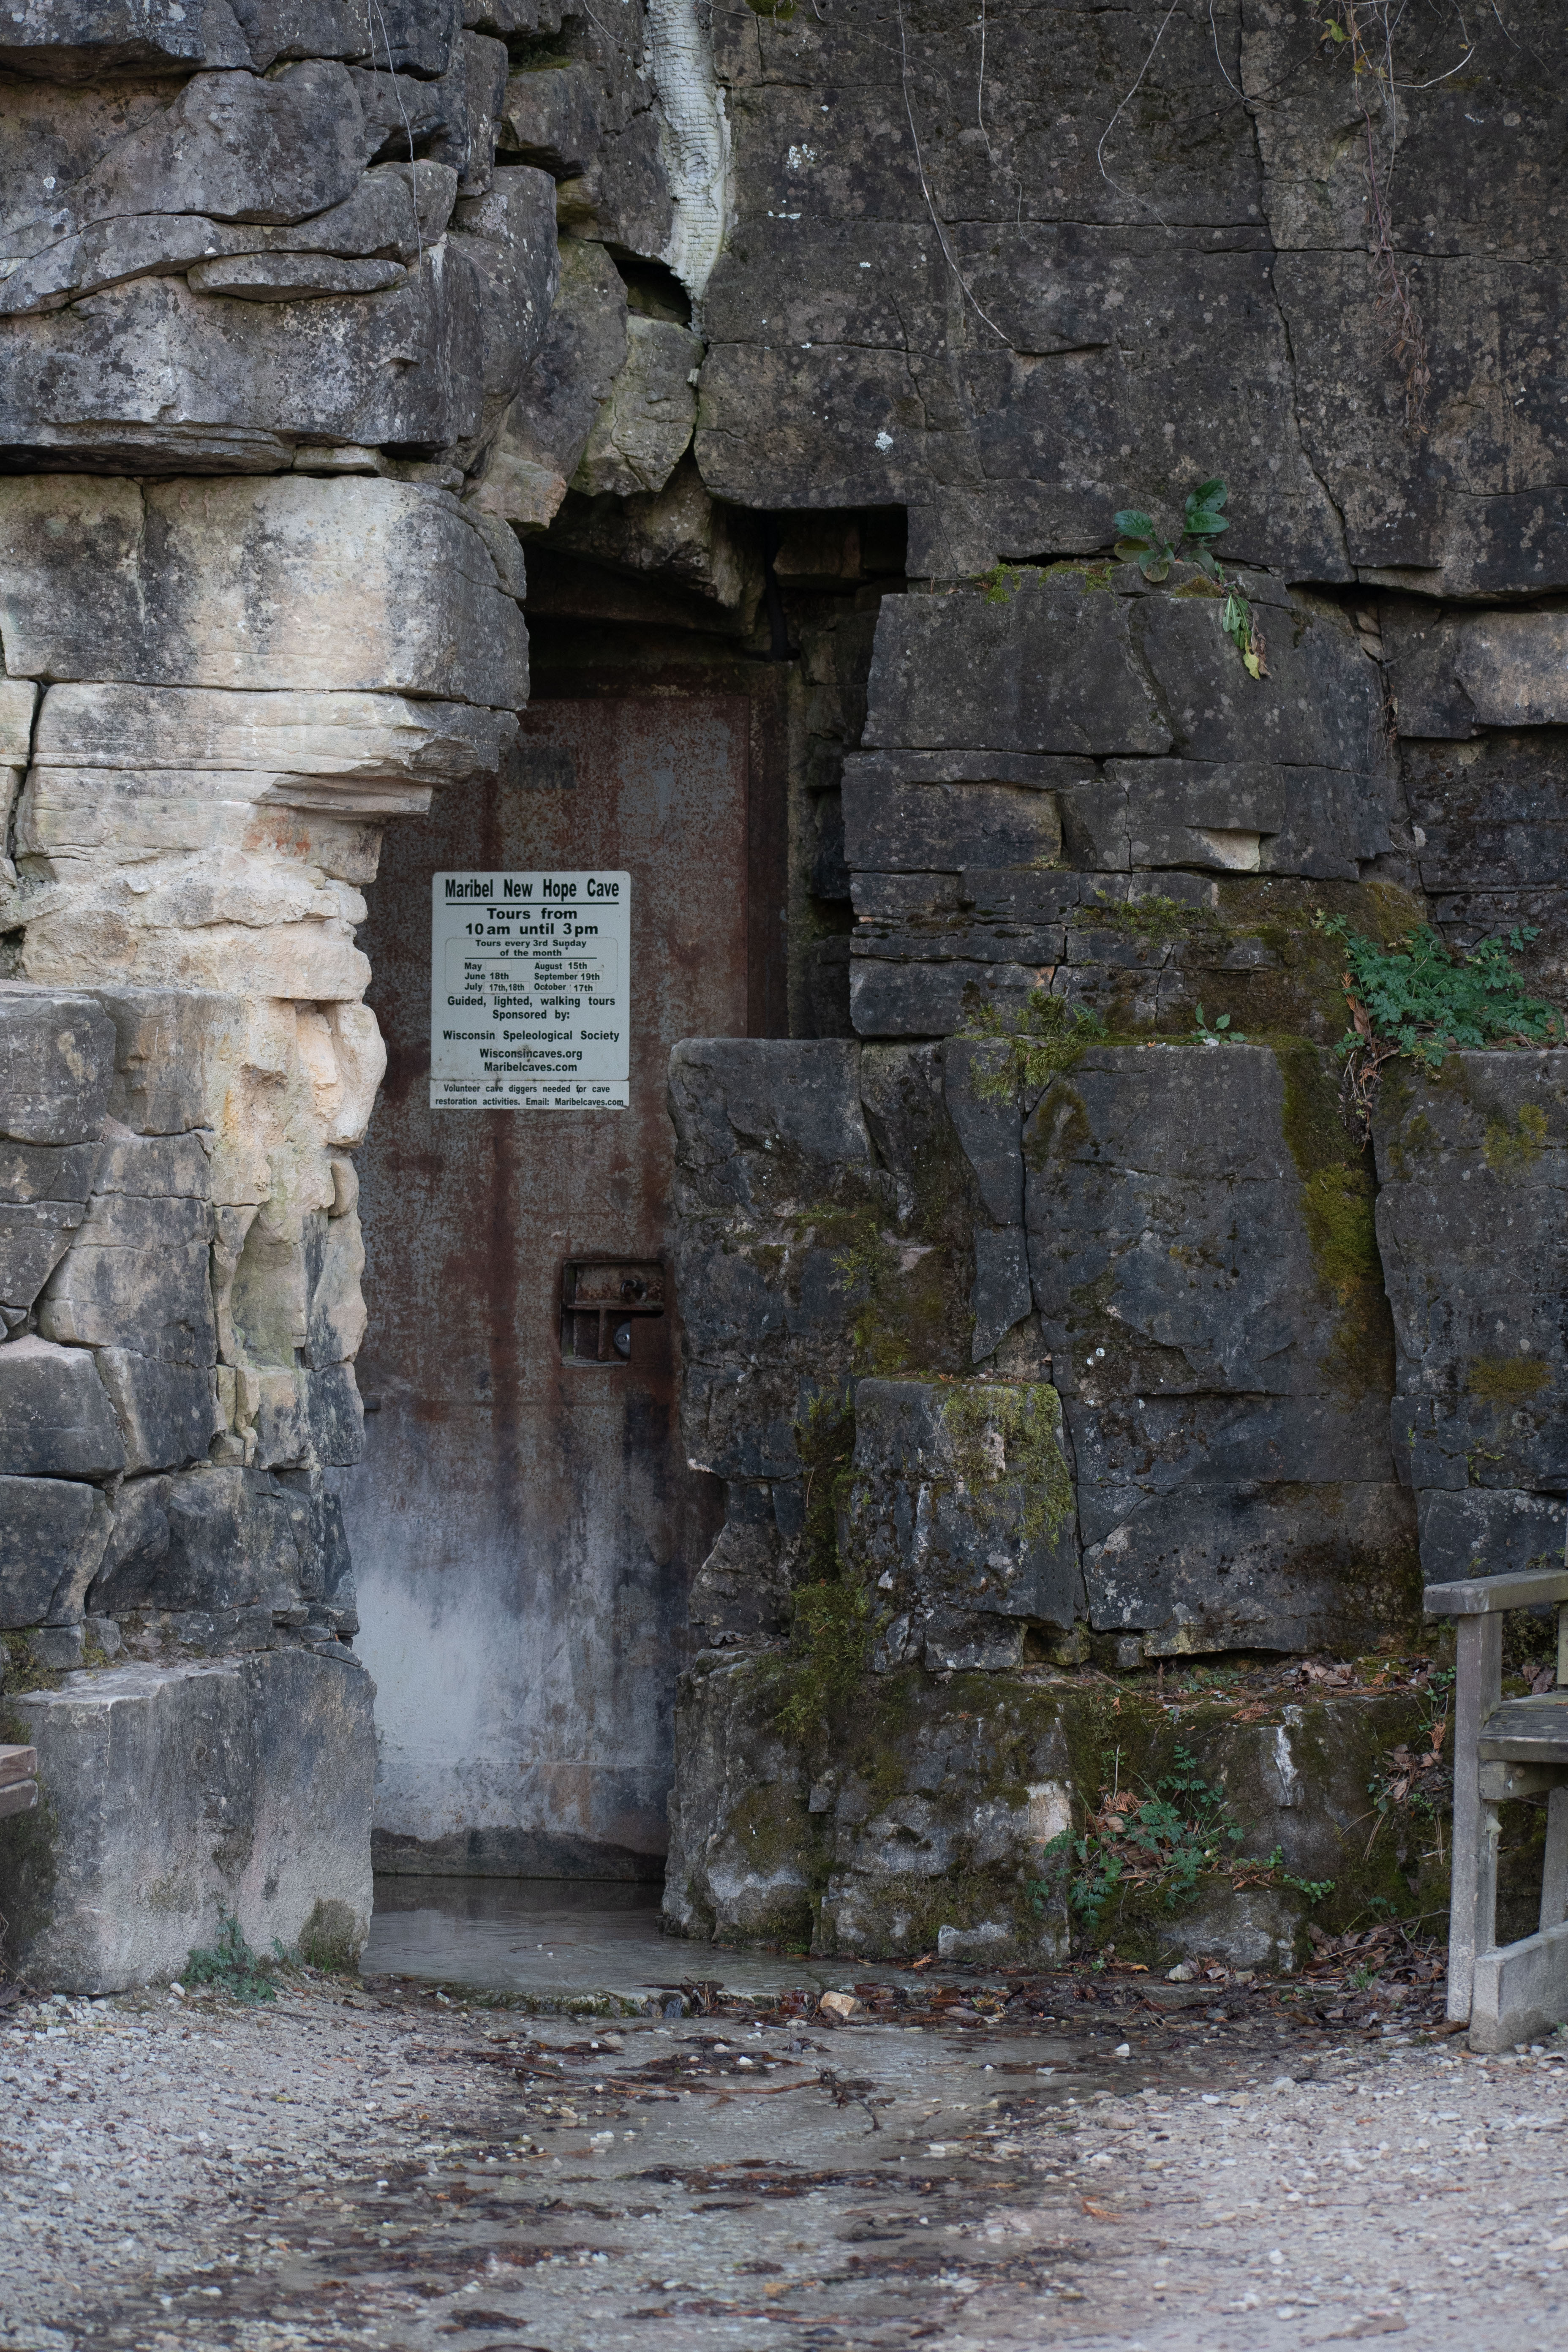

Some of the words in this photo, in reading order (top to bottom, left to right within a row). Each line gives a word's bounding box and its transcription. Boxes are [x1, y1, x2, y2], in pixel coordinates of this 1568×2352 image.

[445, 879, 493, 898] Maribel
[504, 879, 533, 898] New
[543, 878, 577, 901] Hope
[587, 878, 619, 897] Cave
[486, 908, 531, 920] Tours
[541, 907, 577, 920] from
[520, 923, 554, 935] until
[553, 939, 587, 949] Sunday
[464, 962, 482, 972] May
[534, 962, 563, 972] August
[464, 972, 486, 980] June
[490, 972, 509, 980] 18th
[534, 972, 578, 982] September
[580, 973, 600, 981] 19th
[464, 983, 483, 992] July
[534, 983, 566, 991] October
[574, 984, 593, 992] 17th
[447, 996, 486, 1008] Guided,
[494, 996, 533, 1008] lighted,
[540, 996, 580, 1008] walking
[588, 996, 615, 1006] tours
[492, 1009, 547, 1022] Sponsored
[555, 1009, 570, 1022] by:
[443, 1030, 495, 1040] Wisconsin
[503, 1030, 572, 1043] Speleological
[580, 1030, 620, 1043] Society
[479, 1048, 583, 1061] Wisconsincaves.org
[484, 1061, 577, 1072] Maribelcaves.com
[444, 1084, 481, 1092] Volunteer
[508, 1084, 537, 1094] diggers
[543, 1084, 571, 1093] needed
[576, 1084, 587, 1094] for
[436, 1097, 477, 1105] restoration
[482, 1097, 520, 1105] activities.
[526, 1097, 549, 1105] Email:
[555, 1097, 624, 1106] Maribelcaves.com
